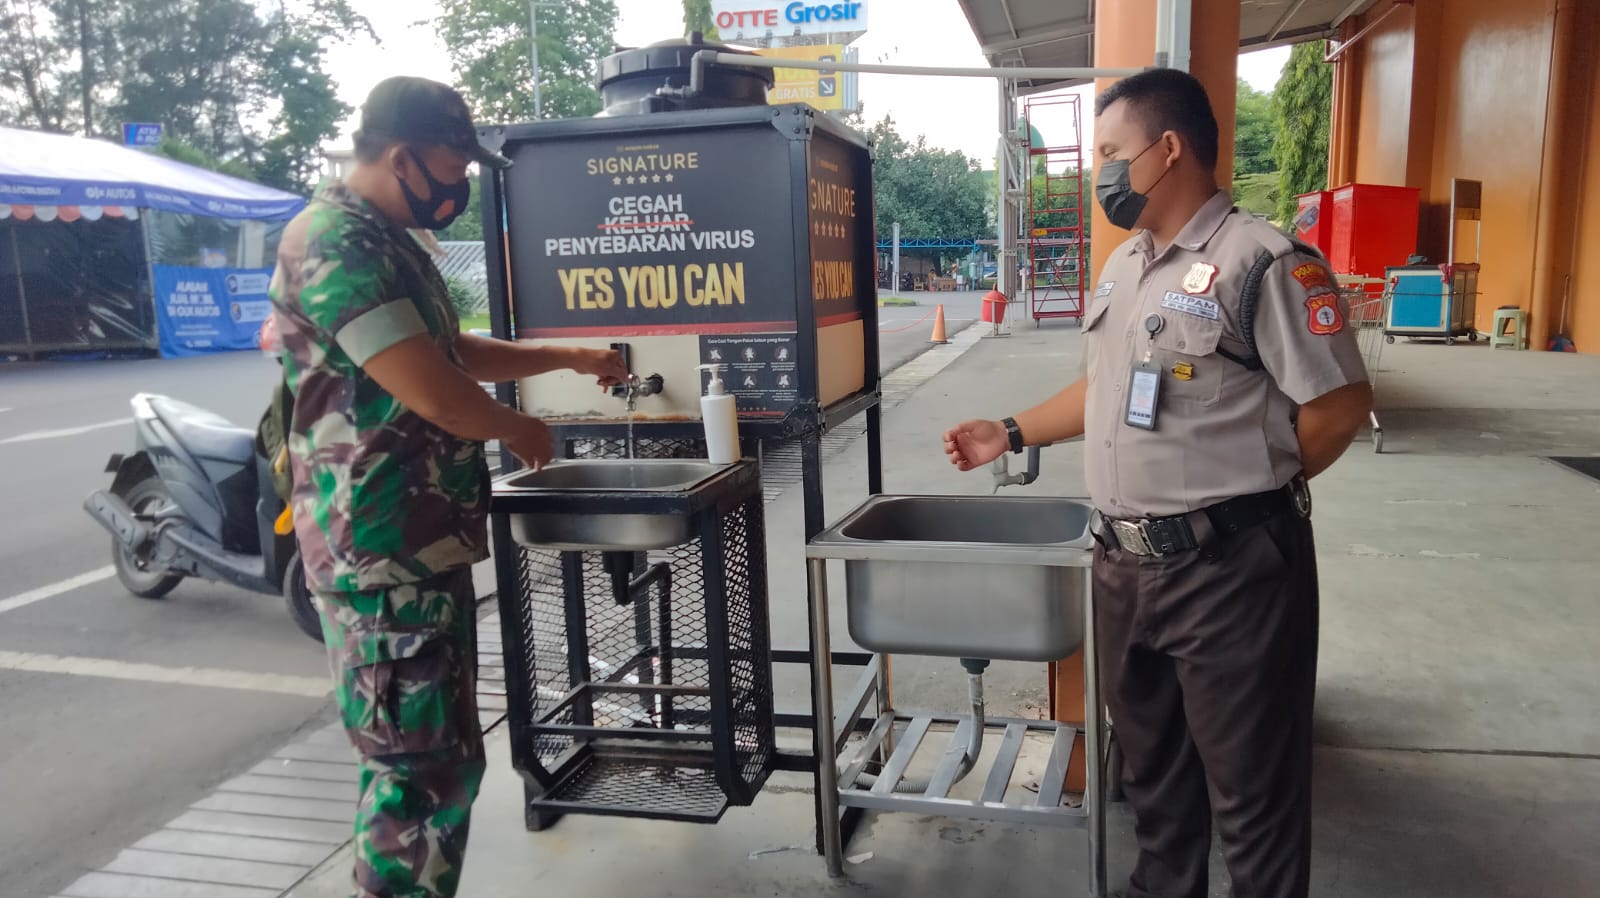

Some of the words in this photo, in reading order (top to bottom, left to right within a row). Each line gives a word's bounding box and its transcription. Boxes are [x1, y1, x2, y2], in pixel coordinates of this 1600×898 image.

[785, 0, 862, 24] Grosir
[776, 86, 817, 100] GRATIS
[586, 152, 699, 175] SIGNATURE
[106, 188, 137, 199] AUTOS
[608, 194, 683, 215] CEGAH
[604, 213, 691, 235] KELUAR
[545, 232, 686, 256] PENYEBARAN
[690, 229, 755, 250] VIRUS
[557, 267, 616, 310] YES
[617, 264, 679, 309] YOU
[683, 262, 745, 306] CAN
[824, 261, 840, 299] YOU
[839, 261, 853, 297] CAN
[1167, 293, 1216, 311] SATPAM
